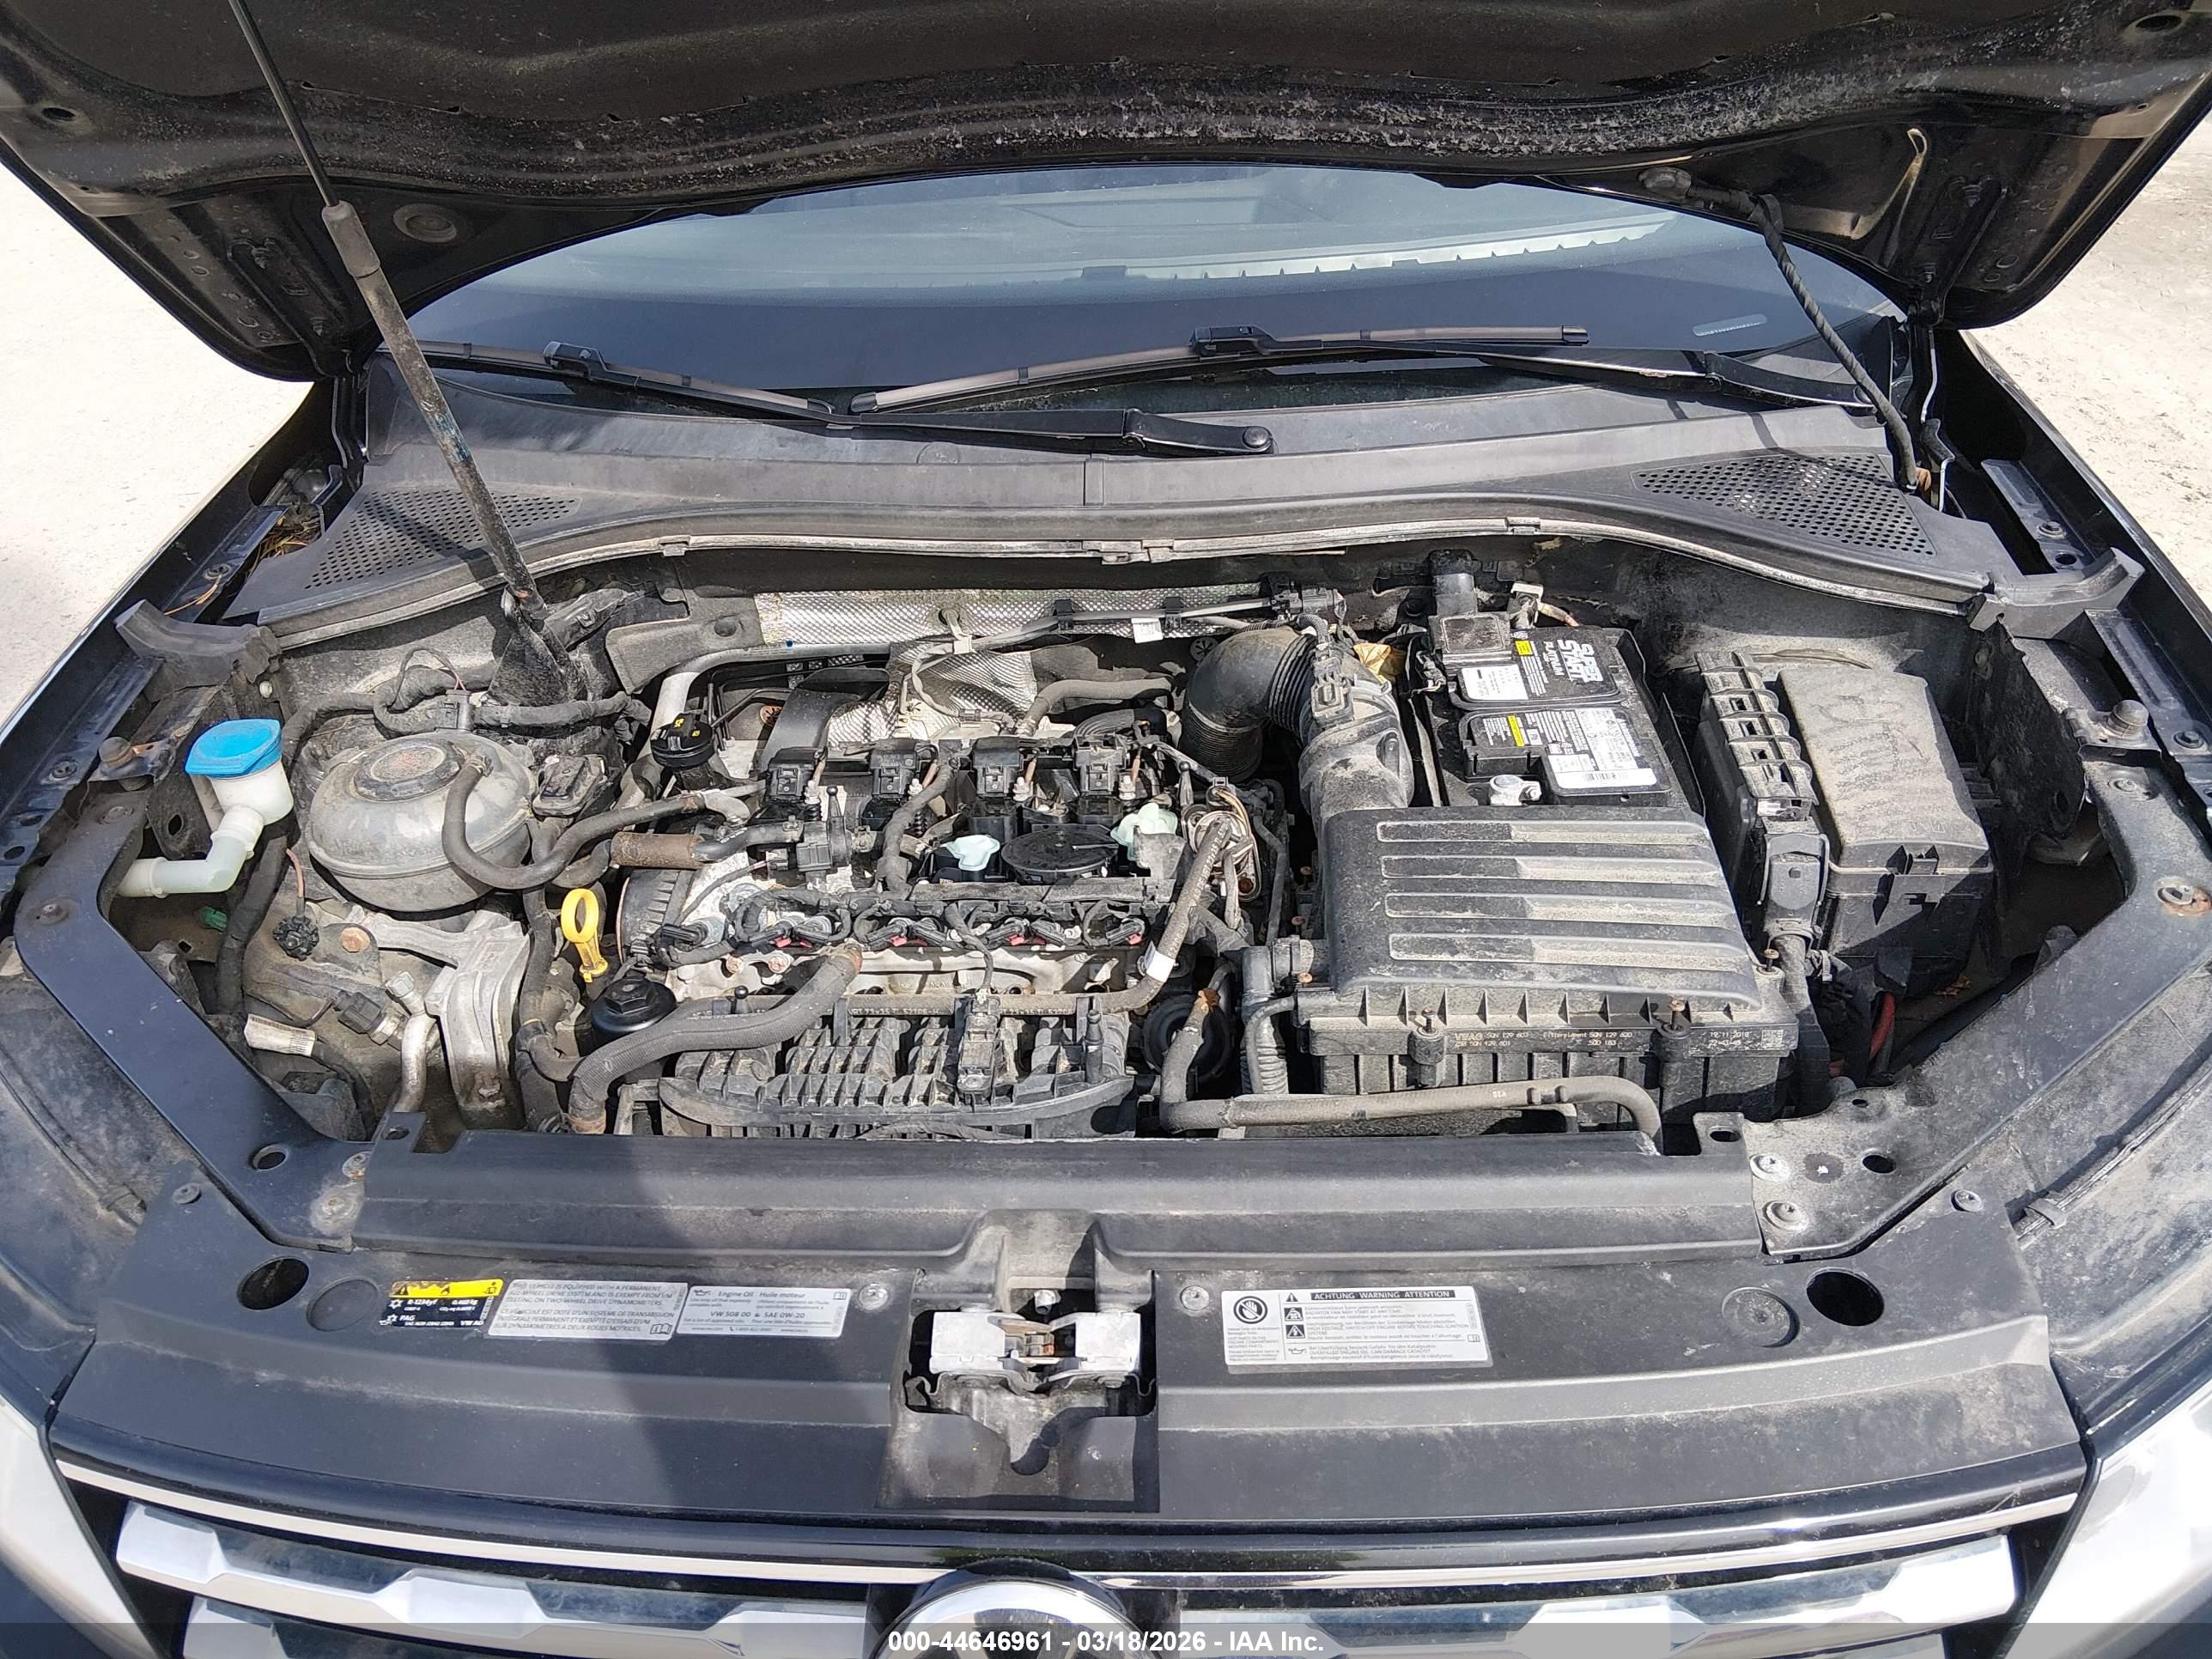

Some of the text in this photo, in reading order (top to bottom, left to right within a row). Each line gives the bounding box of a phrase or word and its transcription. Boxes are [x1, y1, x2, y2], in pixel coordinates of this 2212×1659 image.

[1543, 641, 1565, 675] PLATINUM
[1557, 640, 1583, 678] START
[1578, 644, 1603, 682] SUPER
[718, 1291, 742, 1299] Engine
